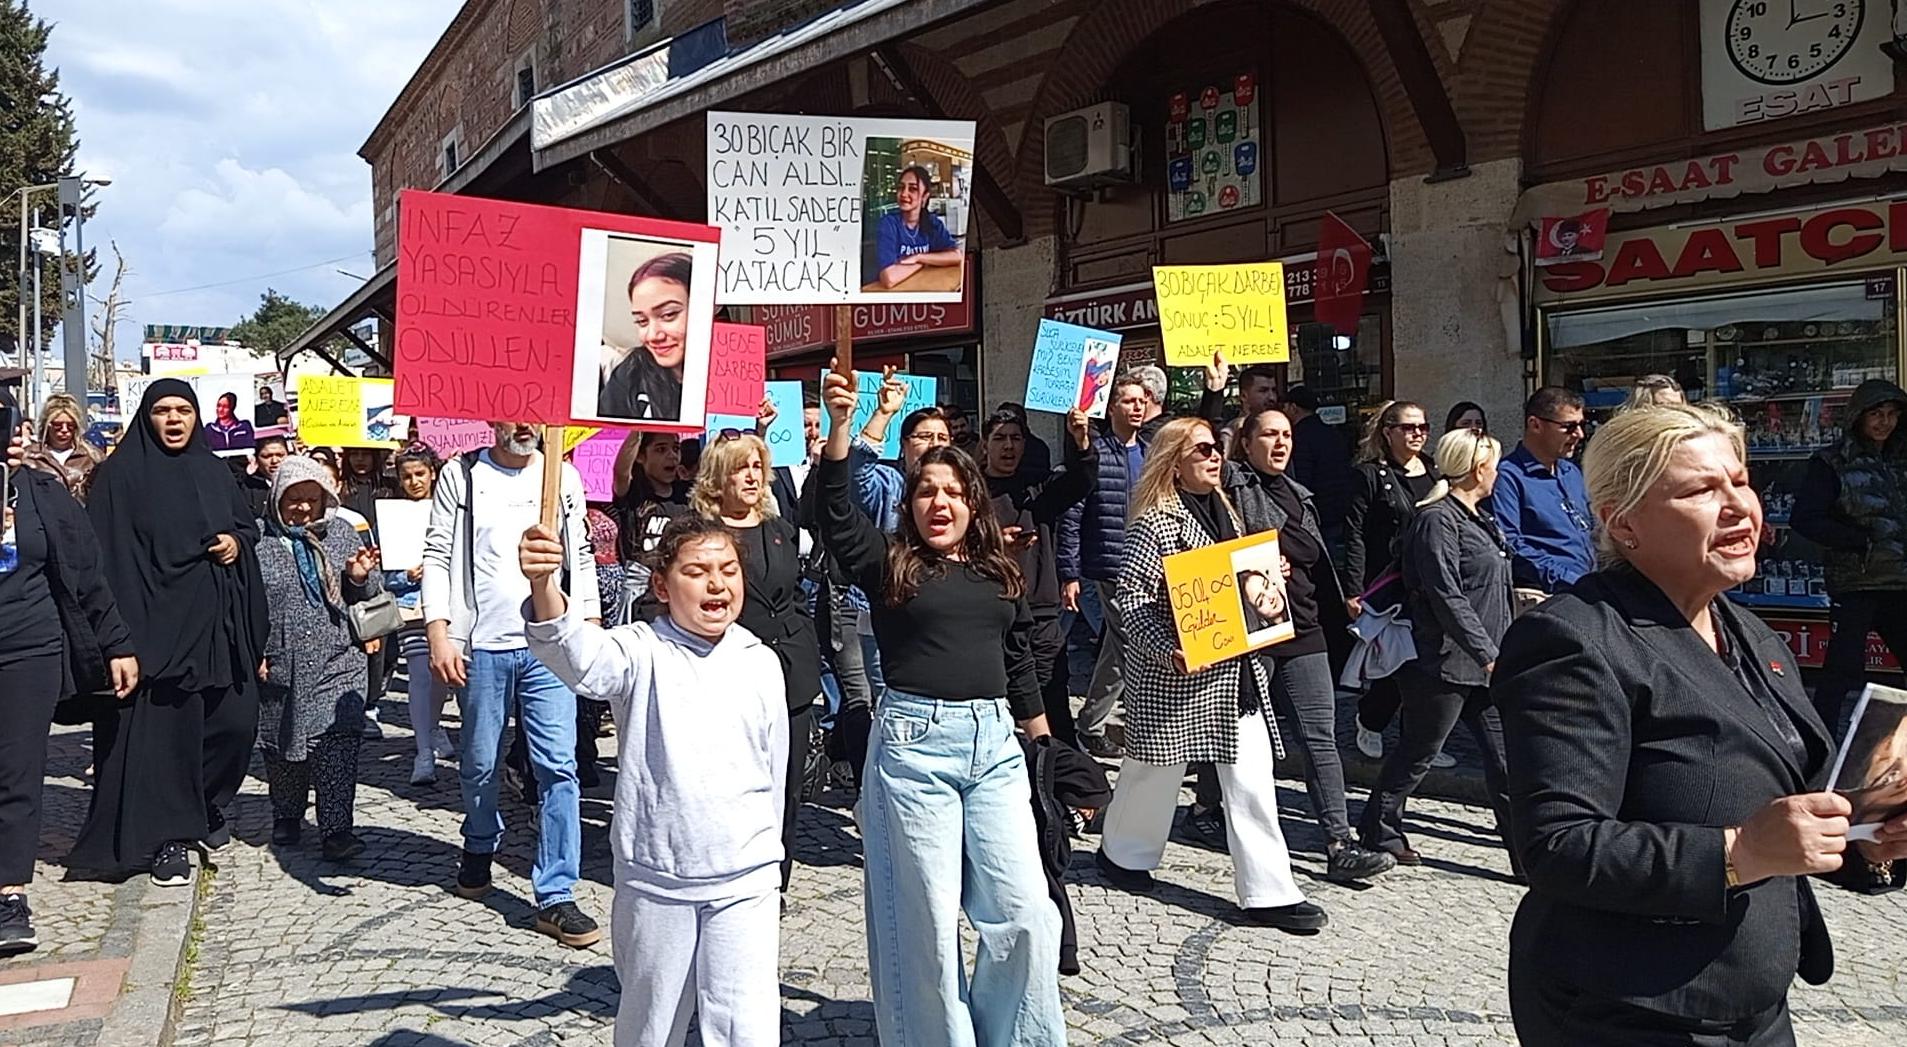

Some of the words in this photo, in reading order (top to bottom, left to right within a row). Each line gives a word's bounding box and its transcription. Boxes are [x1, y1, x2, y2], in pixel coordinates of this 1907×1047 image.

[1740, 27, 1751, 41] 9
[1828, 25, 1841, 39] 4
[1748, 45, 1759, 58] 8
[1809, 43, 1822, 58] 5
[1766, 54, 1778, 69] 7
[1788, 54, 1800, 69] 6
[1737, 76, 1861, 123] ESAT
[713, 160, 767, 188] CAN
[1584, 154, 1739, 205] E-SAAT
[788, 196, 861, 223] SADECE
[403, 244, 563, 297] YASASIYLA
[1287, 270, 1310, 284] 213
[1288, 284, 1310, 298] 778
[1873, 282, 1886, 293] 17
[766, 313, 812, 346] GÜMÜŞ
[1232, 343, 1281, 357] NEREDE
